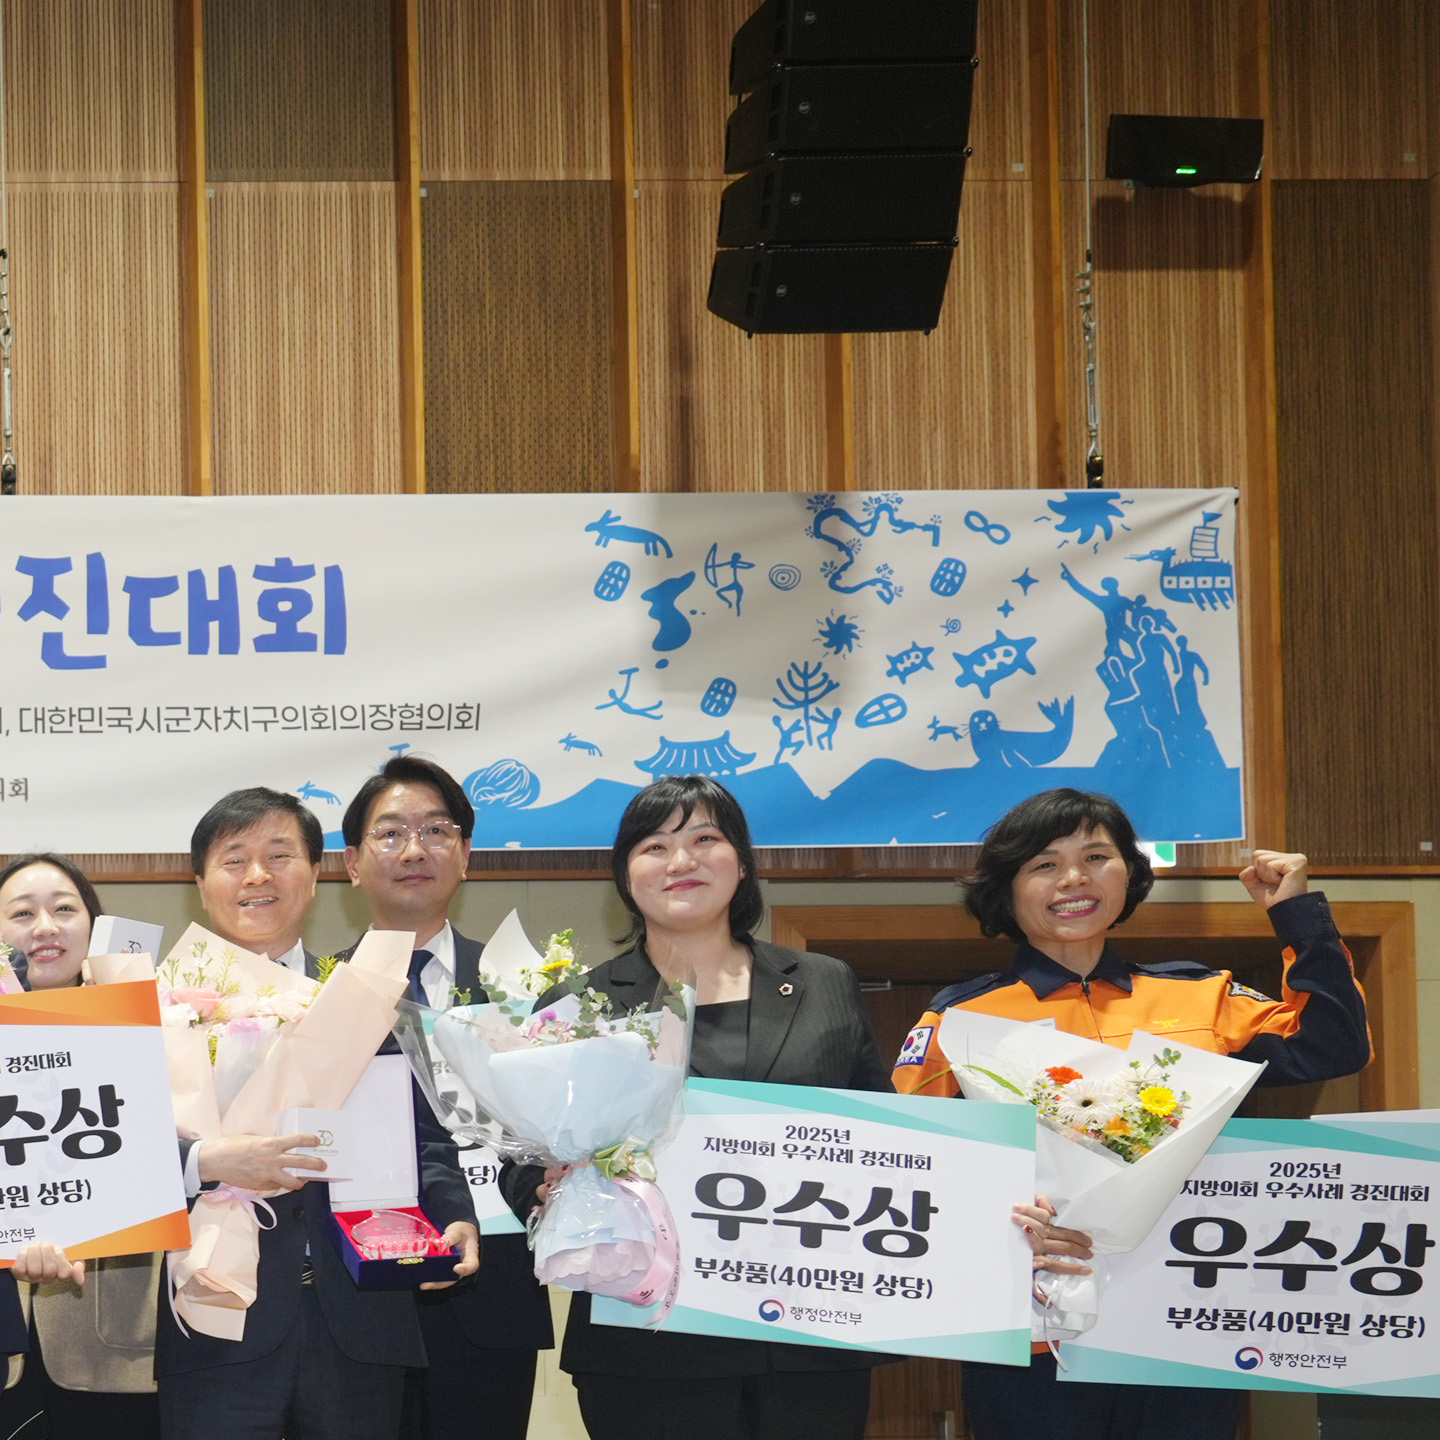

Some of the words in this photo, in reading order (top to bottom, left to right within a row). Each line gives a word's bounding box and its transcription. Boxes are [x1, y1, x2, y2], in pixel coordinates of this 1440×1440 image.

[19, 702, 481, 734] 대한민국시군자치구의회의장협의회
[5, 1051, 72, 1074] 경진대회
[785, 1124, 851, 1145] 2025년
[703, 1136, 775, 1158] 지방의회
[781, 1143, 854, 1164] 우수사례
[859, 1149, 932, 1171] 경진대회
[462, 1165, 497, 1186] 당)
[1269, 1161, 1341, 1180] 2025년
[37, 1178, 92, 1206] 상당)
[1179, 1179, 1258, 1198] 지방의회
[1265, 1181, 1343, 1200] 우수사례
[1349, 1184, 1430, 1203] 경진대회
[690, 1171, 939, 1258] 우수상
[1165, 1215, 1436, 1296] 우수상
[694, 1256, 864, 1294] 부상품(40만원
[872, 1274, 933, 1300] 상당)
[790, 1305, 863, 1326] 행정안전부
[1166, 1306, 1350, 1336] 부상품(40만원
[1359, 1314, 1426, 1339] 상당)
[1268, 1352, 1347, 1369] 행정안전부
